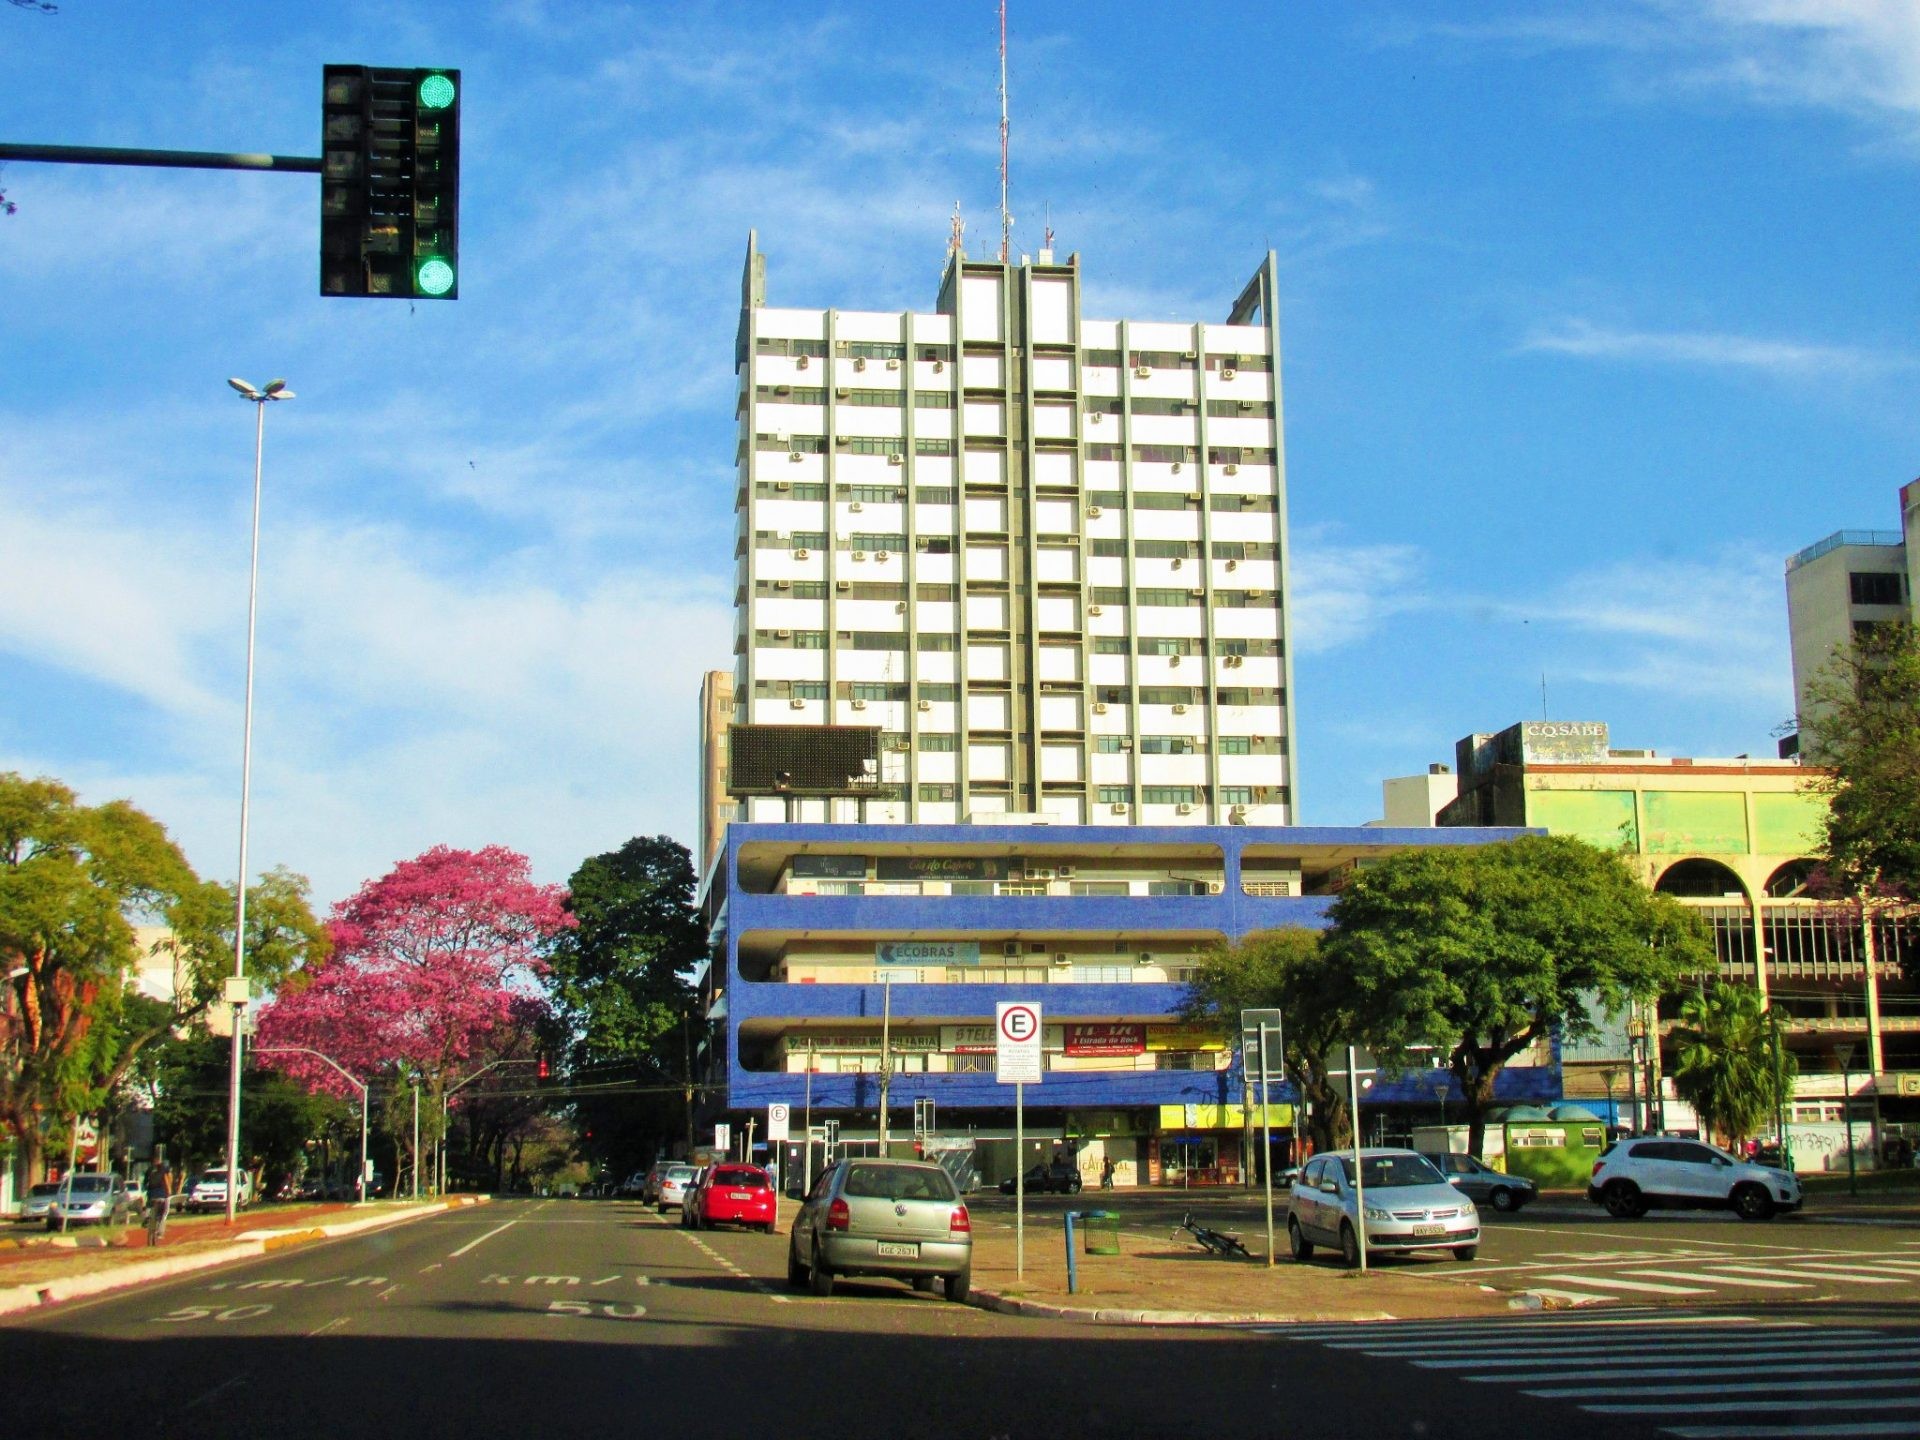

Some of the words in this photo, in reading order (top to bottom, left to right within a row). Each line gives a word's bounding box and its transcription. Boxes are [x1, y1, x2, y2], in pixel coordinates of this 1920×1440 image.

[896, 946, 955, 957] ECOBRAS
[1011, 1014, 1026, 1033] E
[1119, 1036, 1139, 1044] Rock
[774, 1106, 783, 1119] E
[150, 1303, 274, 1322] 50
[545, 1300, 648, 1318] 50
